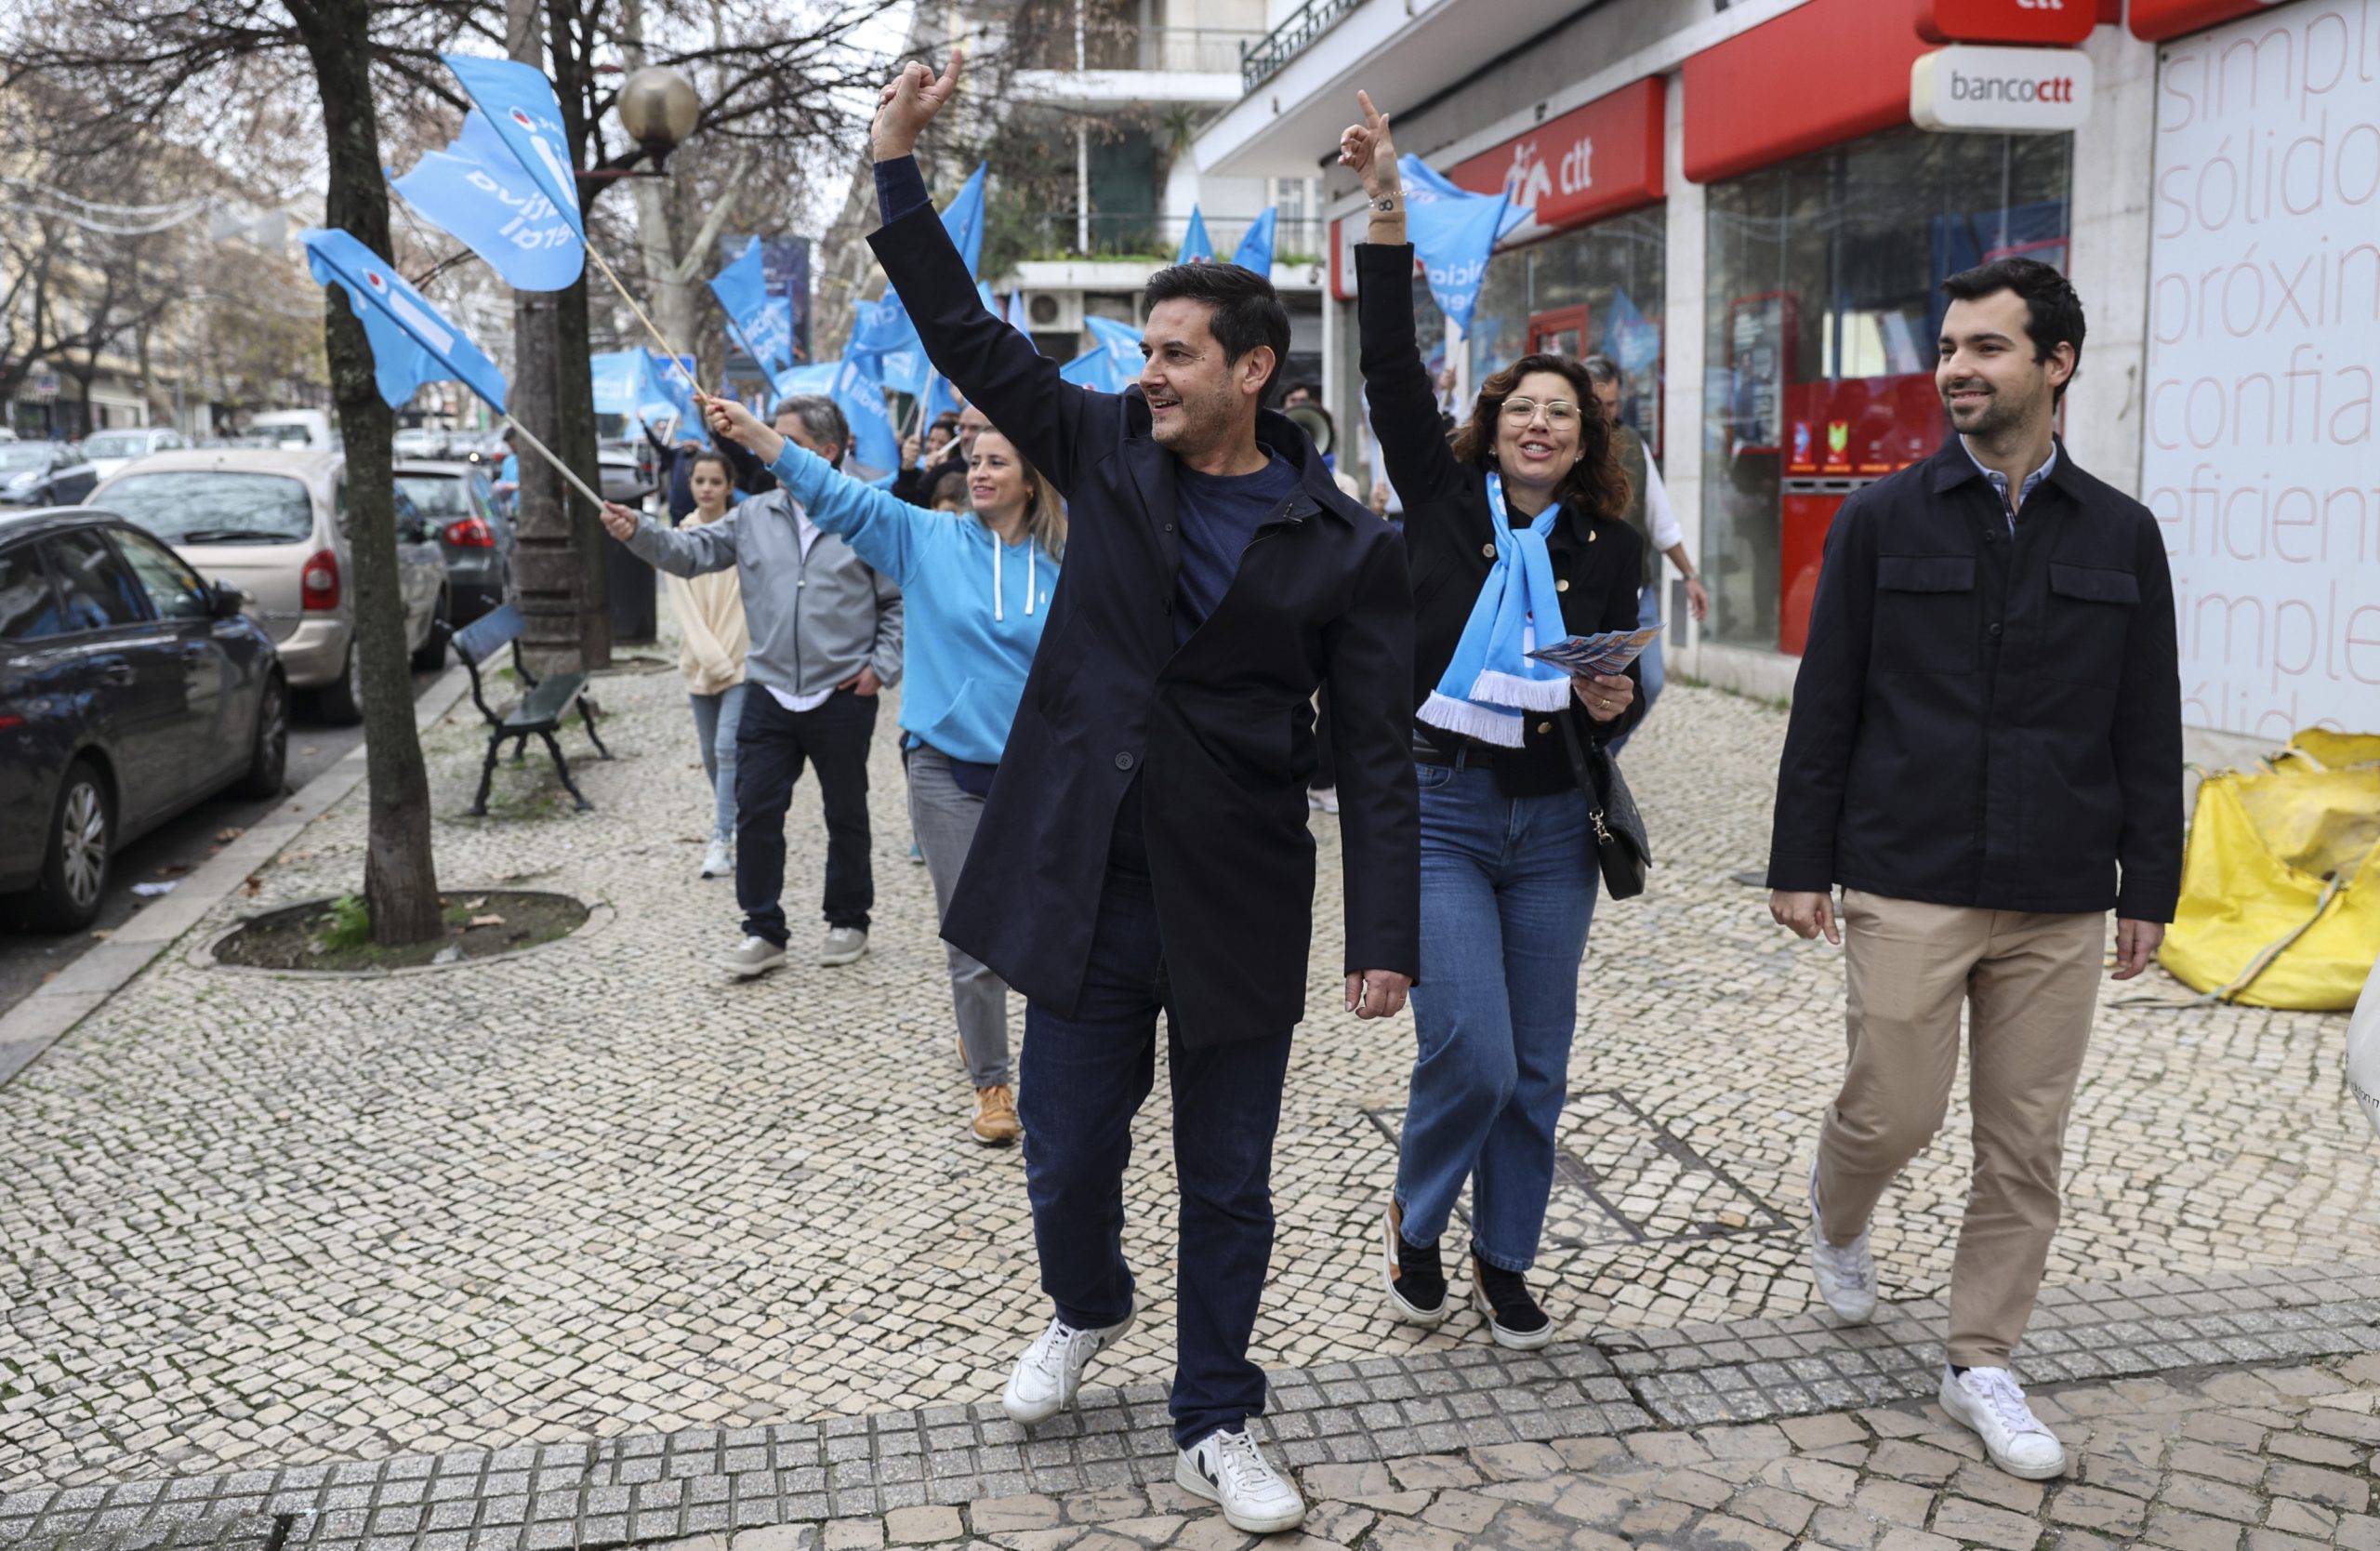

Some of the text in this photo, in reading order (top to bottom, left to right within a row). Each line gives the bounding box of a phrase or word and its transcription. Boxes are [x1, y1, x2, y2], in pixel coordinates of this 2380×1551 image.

[1950, 71, 2073, 103] bancoctt
[2159, 0, 2380, 133] simpl
[1559, 136, 1593, 196] ctt
[2155, 108, 2380, 240] sólido
[2149, 343, 2373, 451] confia
[2180, 578, 2380, 695] imple
